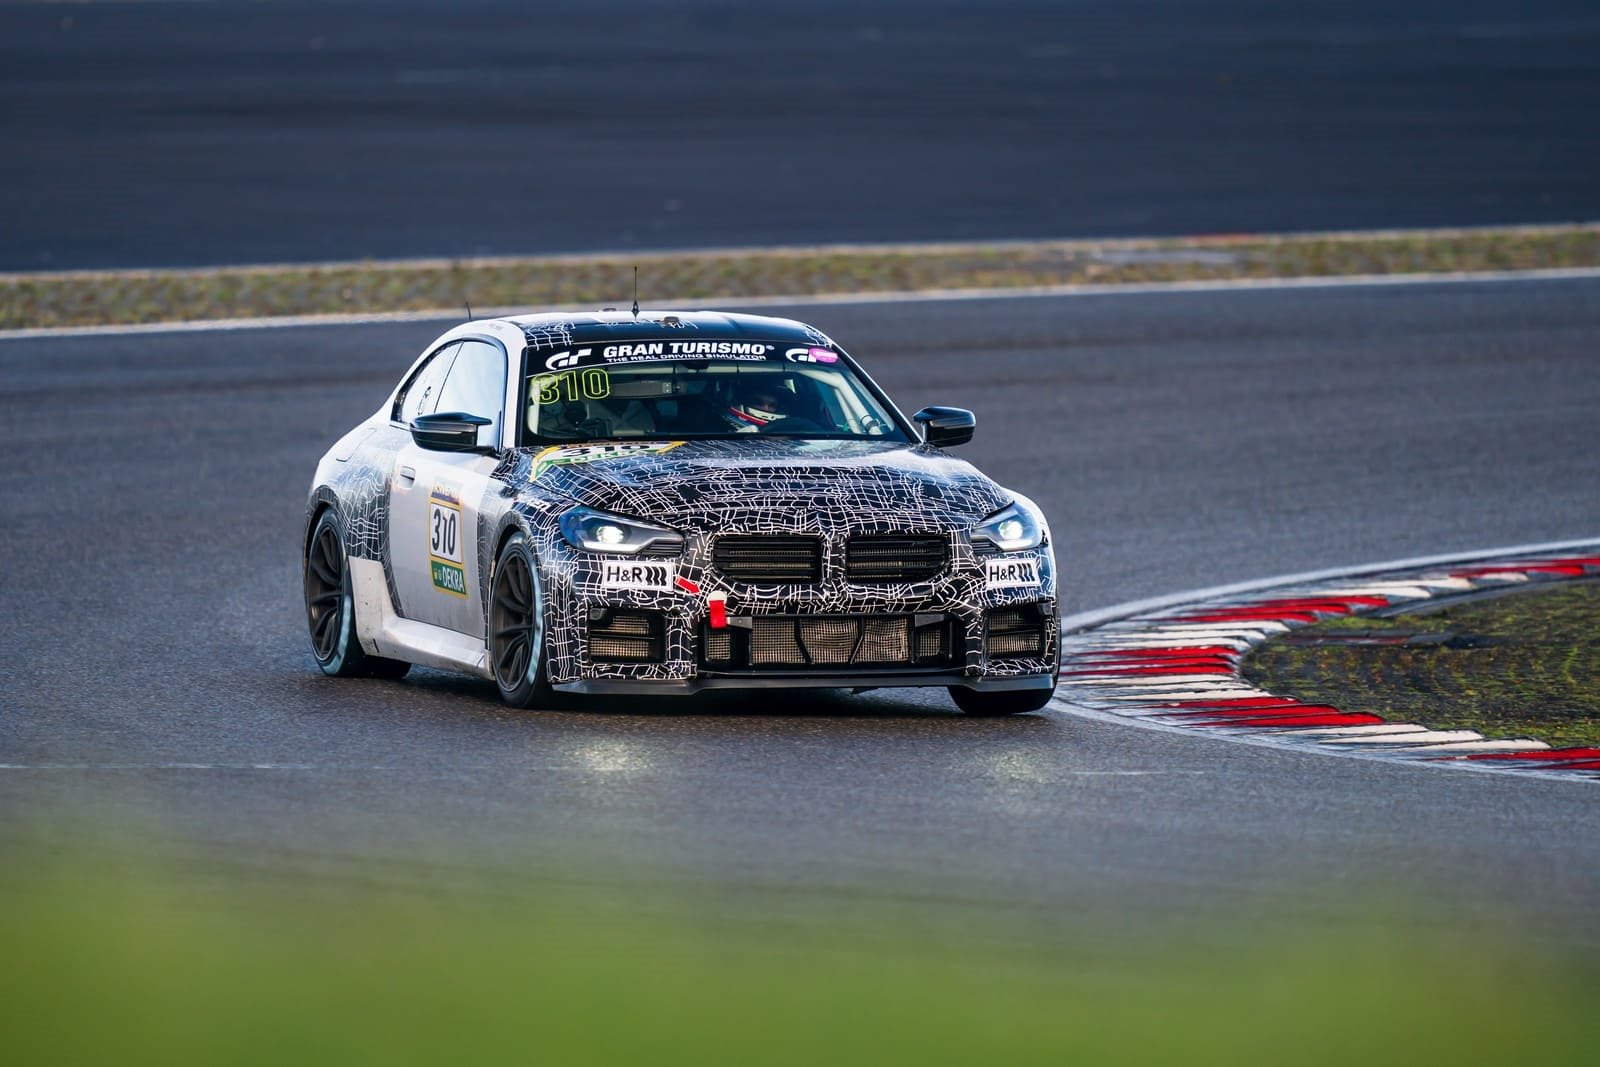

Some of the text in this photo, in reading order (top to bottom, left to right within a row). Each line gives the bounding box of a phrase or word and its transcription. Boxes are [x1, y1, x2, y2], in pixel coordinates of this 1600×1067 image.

[603, 343, 663, 358] GRAN
[660, 352, 703, 360] DRIVING
[705, 353, 767, 361] SIMULATOR
[531, 368, 610, 405] 310
[562, 445, 650, 458] 310
[432, 508, 457, 556] 310
[442, 566, 465, 593] DEKRA
[607, 566, 643, 582] H&R
[990, 564, 1017, 582] H&R
